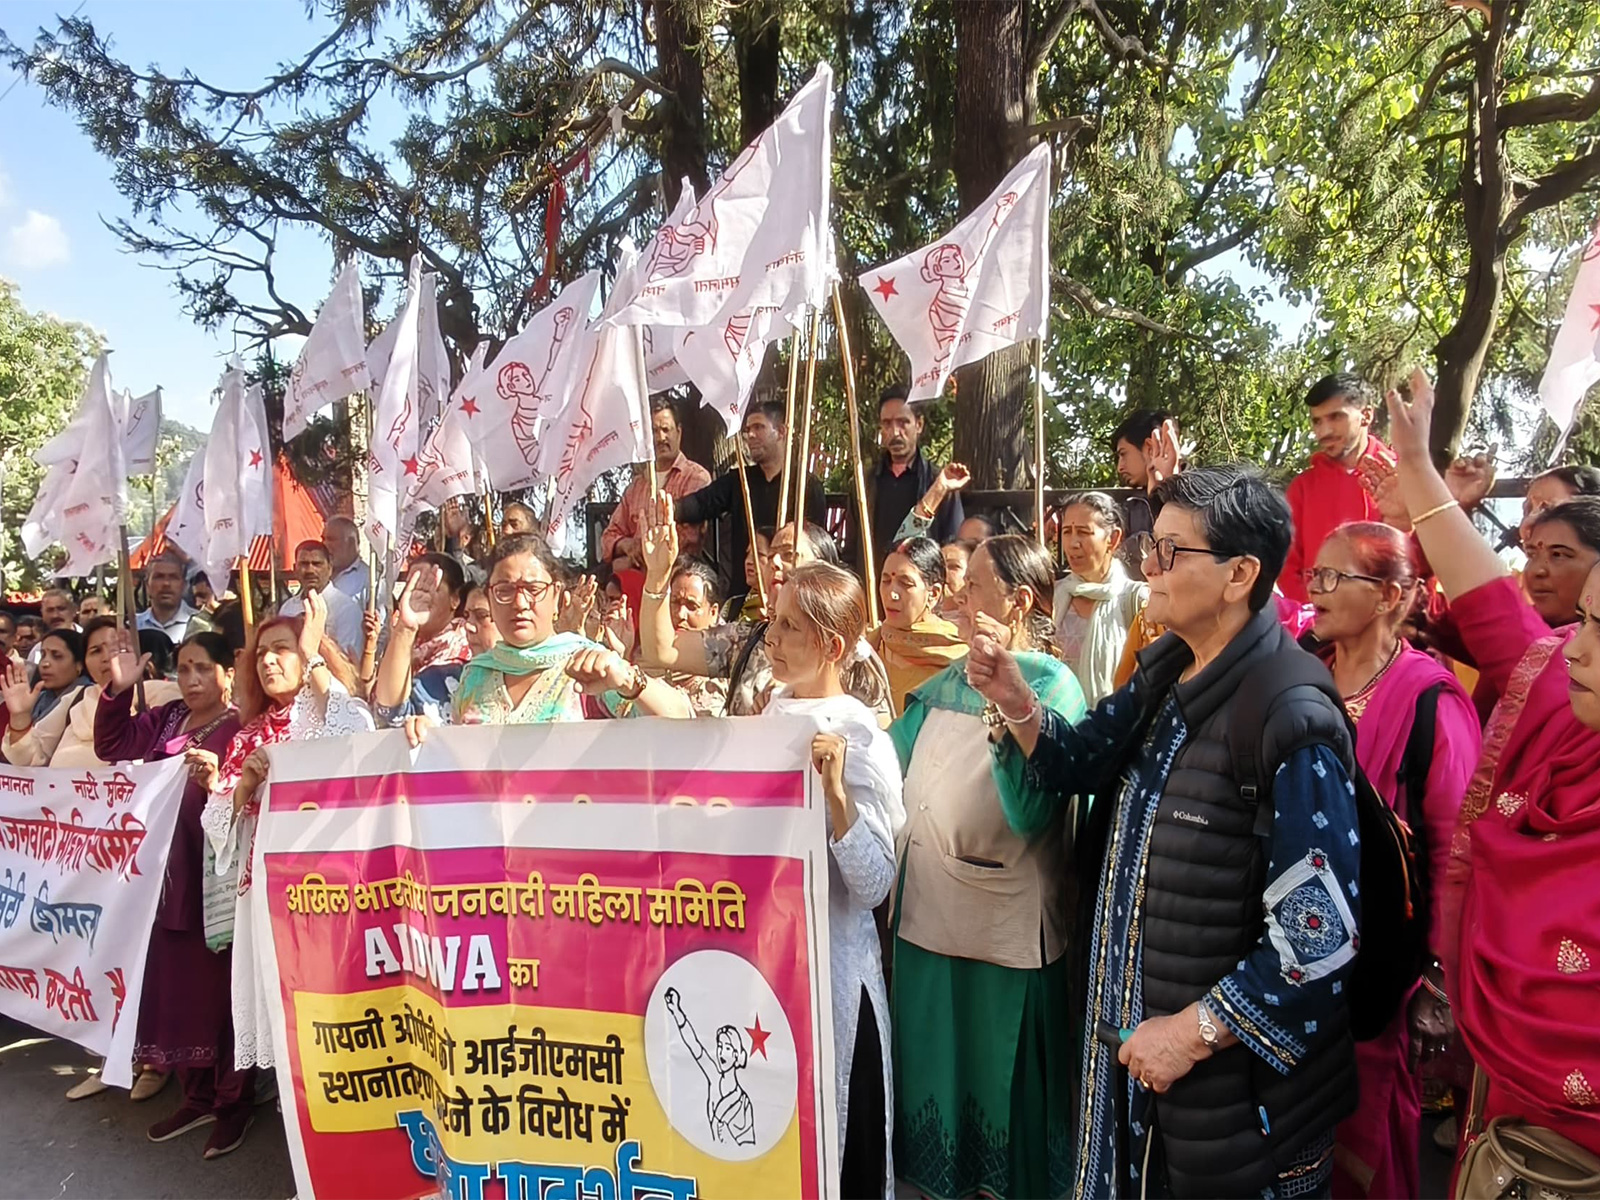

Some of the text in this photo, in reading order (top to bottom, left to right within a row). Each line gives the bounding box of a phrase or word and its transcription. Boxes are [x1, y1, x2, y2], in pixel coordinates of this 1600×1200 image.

[0, 774, 34, 796] मानता
[71, 771, 99, 800] नारी
[1178, 811, 1209, 825] Columbia
[286, 872, 349, 914] अखिल
[354, 869, 428, 916] भारतीय
[431, 870, 546, 917] जनवादी
[549, 872, 642, 924] महिला
[646, 877, 747, 929] समिति
[364, 923, 540, 991] AIDWA का
[312, 1008, 386, 1053] गायनी
[464, 1025, 625, 1085] आईजीएमसी
[478, 1085, 512, 1134] के
[516, 1084, 595, 1143] विरोध
[599, 1094, 631, 1143] में
